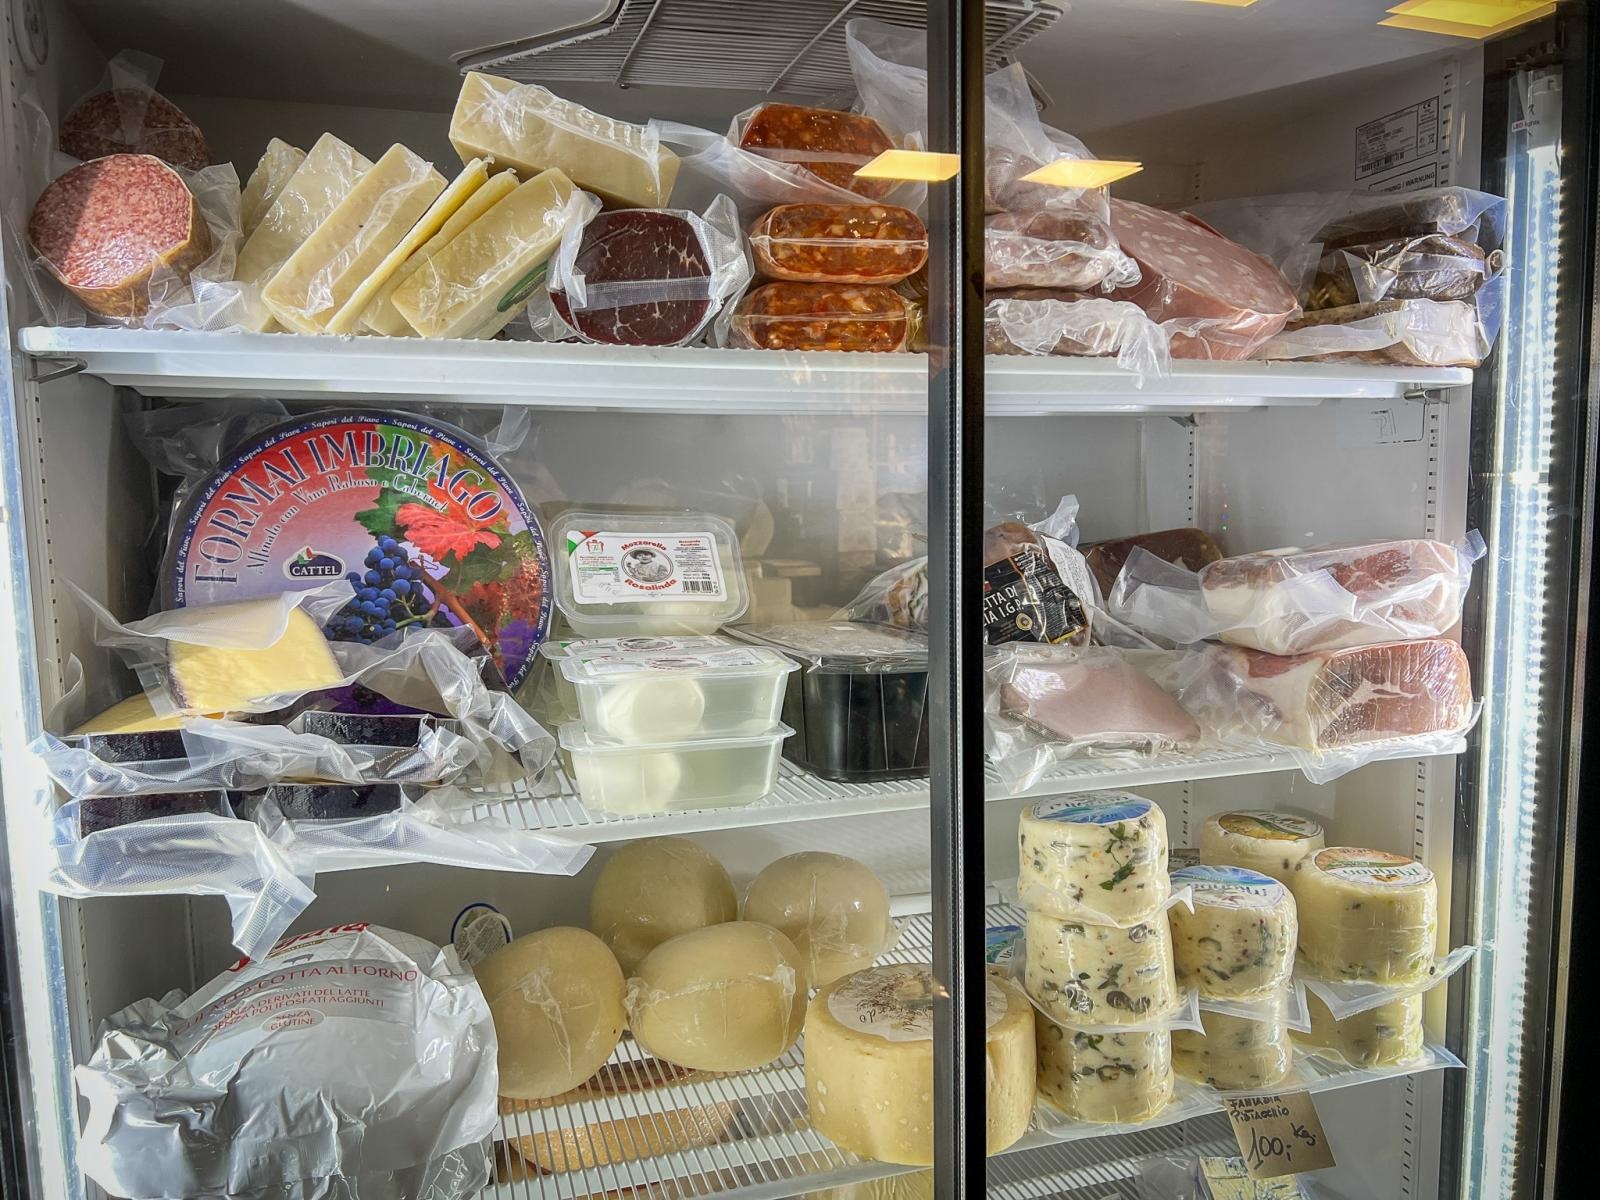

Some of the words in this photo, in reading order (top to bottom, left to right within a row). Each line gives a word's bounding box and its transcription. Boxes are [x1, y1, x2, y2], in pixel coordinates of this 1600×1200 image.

[310, 418, 338, 429] Sapori
[341, 415, 354, 424] del
[391, 418, 419, 431] Sapori
[419, 425, 434, 435] del
[464, 447, 487, 467] Sapori
[487, 465, 500, 478] del
[279, 505, 300, 524] con
[290, 486, 329, 506] Vino
[326, 470, 379, 493] Raboso
[392, 473, 450, 513] Cabernet
[194, 446, 311, 585] FORMAI
[303, 430, 503, 521] IMBRIAGO
[620, 540, 667, 551] Mozzarella
[291, 565, 340, 577] CATTEL
[624, 578, 678, 591] Rosalinda
[257, 966, 323, 990] COTTA
[352, 965, 419, 982] FORNO
[257, 988, 313, 1007] DERIVATI
[313, 987, 336, 997] DEL
[337, 987, 371, 998] LATTE
[328, 995, 385, 1008] AGGIUNTI
[269, 1017, 317, 1031] GLUTINE
